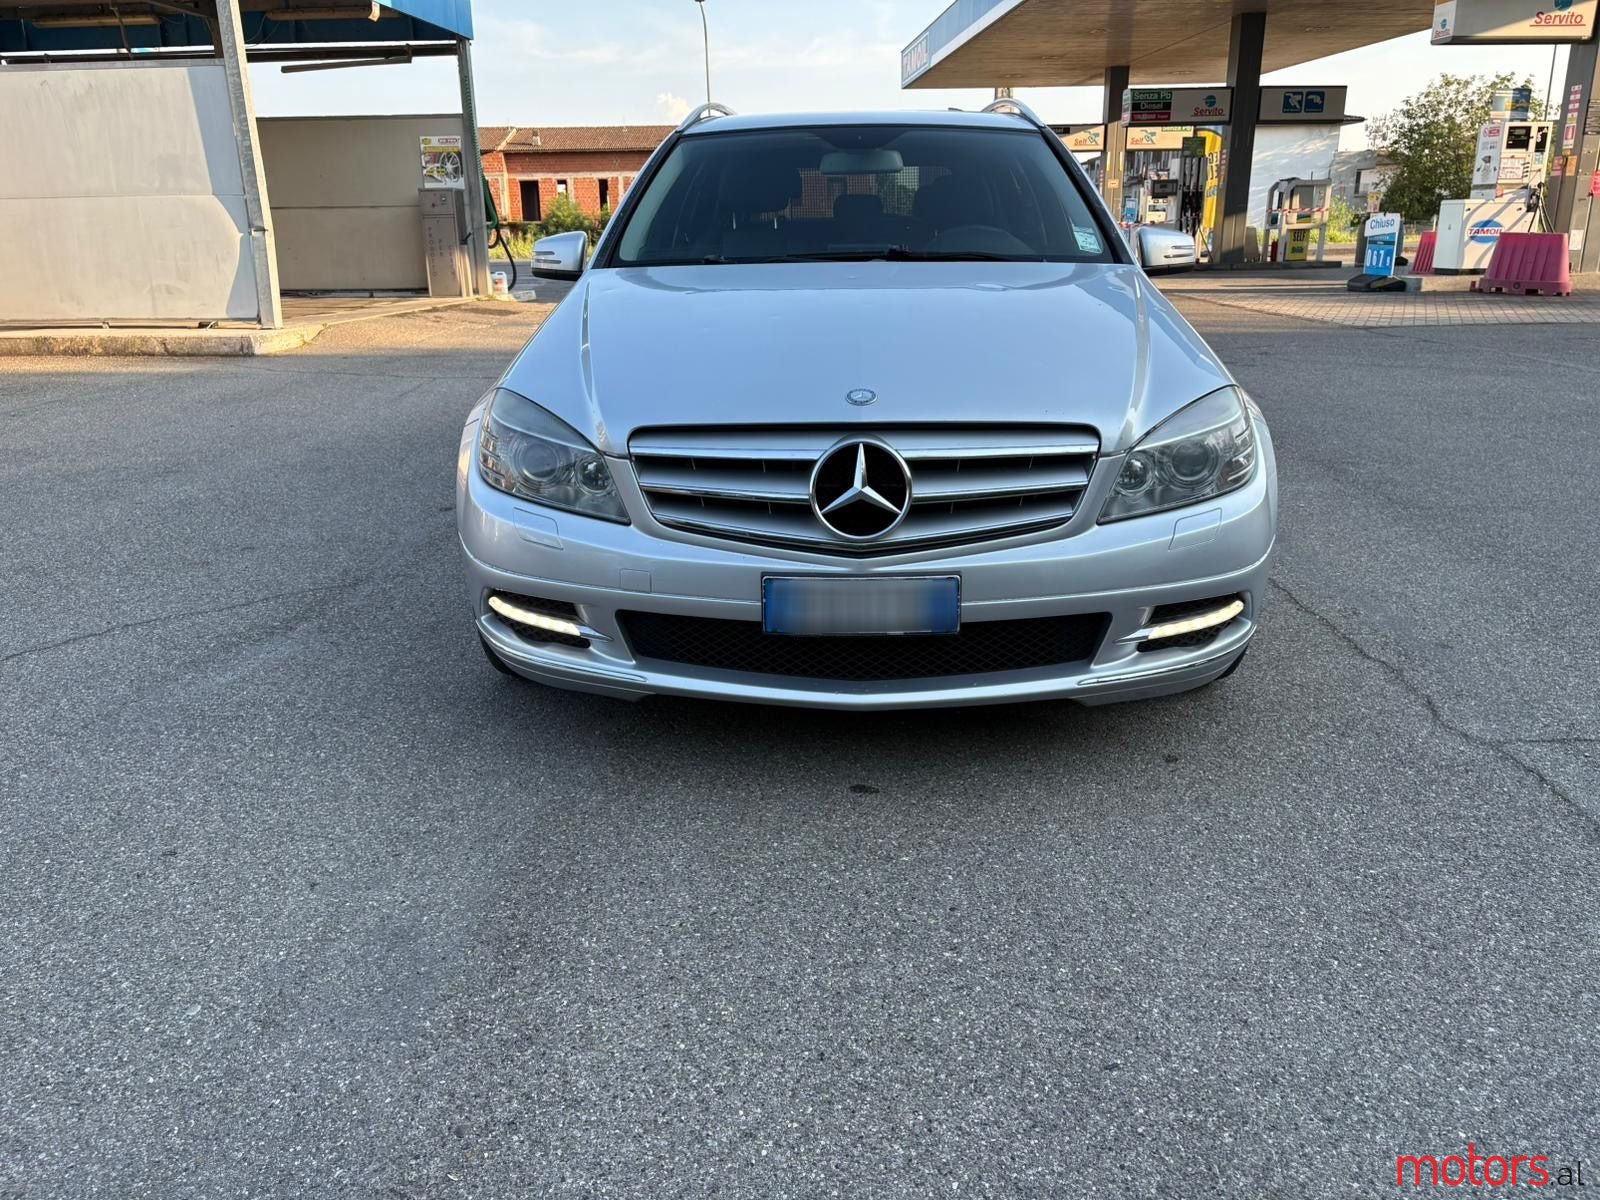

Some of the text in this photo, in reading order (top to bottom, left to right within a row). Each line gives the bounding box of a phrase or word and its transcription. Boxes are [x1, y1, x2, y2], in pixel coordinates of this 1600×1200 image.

[1534, 11, 1584, 25] Servito
[1133, 91, 1158, 100] Senza
[1140, 101, 1163, 110] Diesel
[1192, 106, 1225, 117] Servito
[1370, 218, 1395, 230] Chiuso
